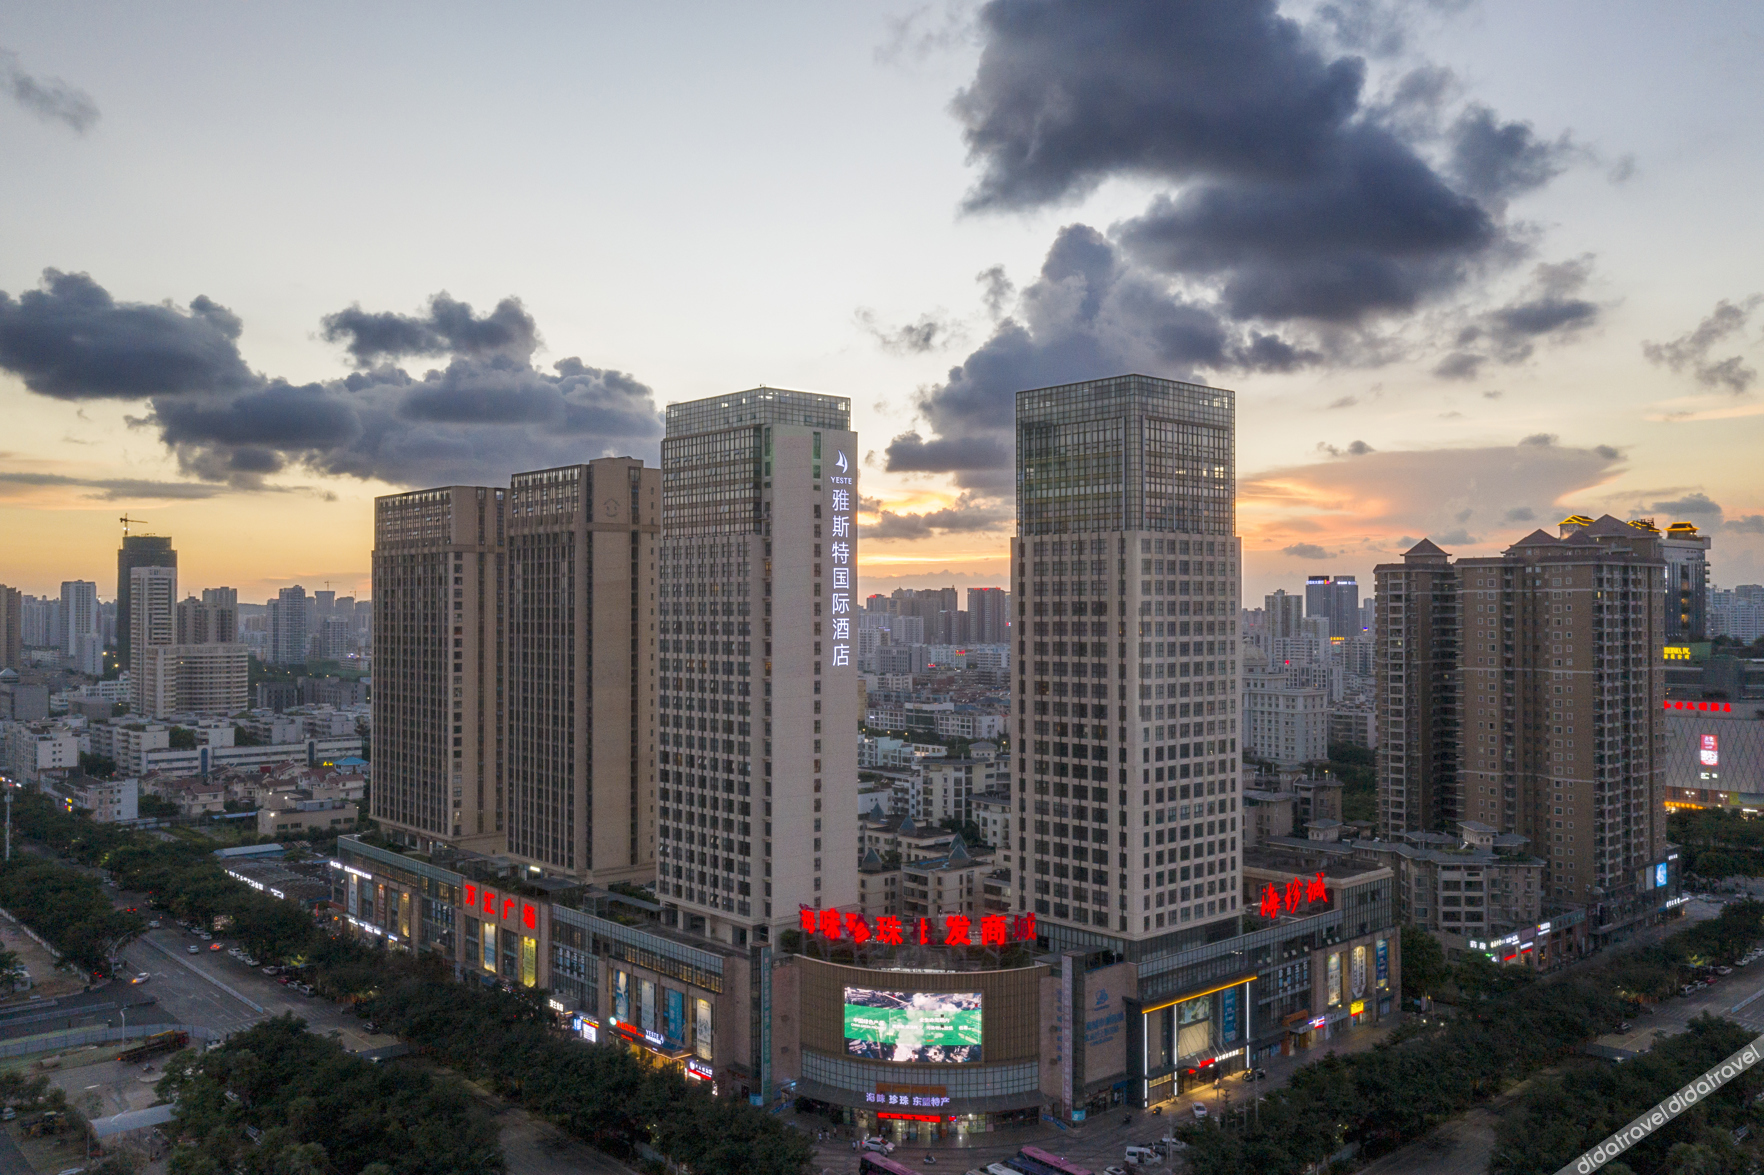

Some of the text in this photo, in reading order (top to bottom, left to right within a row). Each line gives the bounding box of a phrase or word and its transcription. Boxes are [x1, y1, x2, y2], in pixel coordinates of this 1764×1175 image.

[830, 476, 852, 485] YESTE
[832, 489, 850, 667] 雅斯特国际酒店
[464, 883, 536, 930] 万汇广场
[1260, 871, 1328, 919] 海珍城
[798, 902, 1037, 946] 海味珍珠批发商城
[865, 1092, 951, 1107] 海味 珍珠 东盟特产
